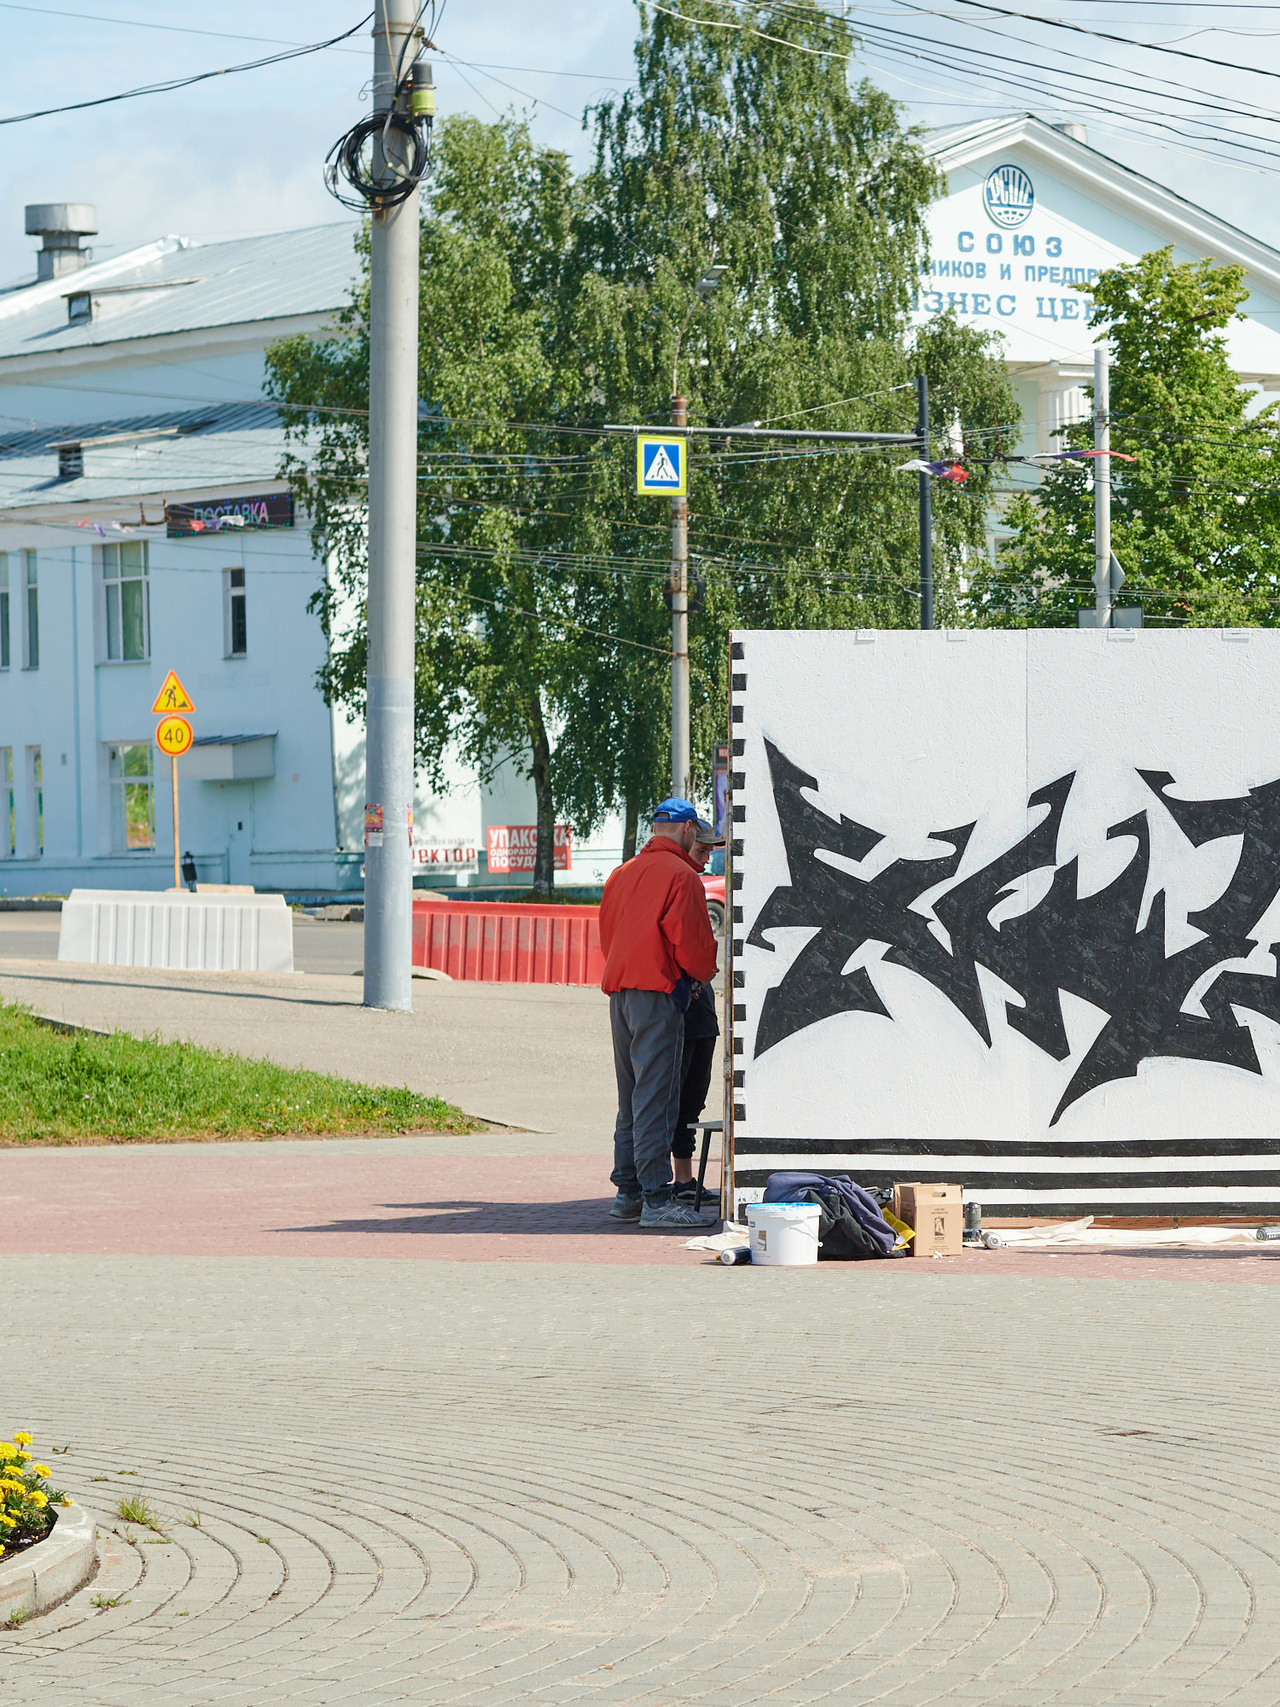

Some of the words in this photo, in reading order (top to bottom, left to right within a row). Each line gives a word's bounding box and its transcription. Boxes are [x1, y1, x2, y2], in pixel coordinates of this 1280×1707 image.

[957, 231, 1062, 257] СОЮЗ
[1000, 263, 1011, 280] И
[164, 728, 184, 743] 40
[489, 828, 569, 848] УПАКОКА
